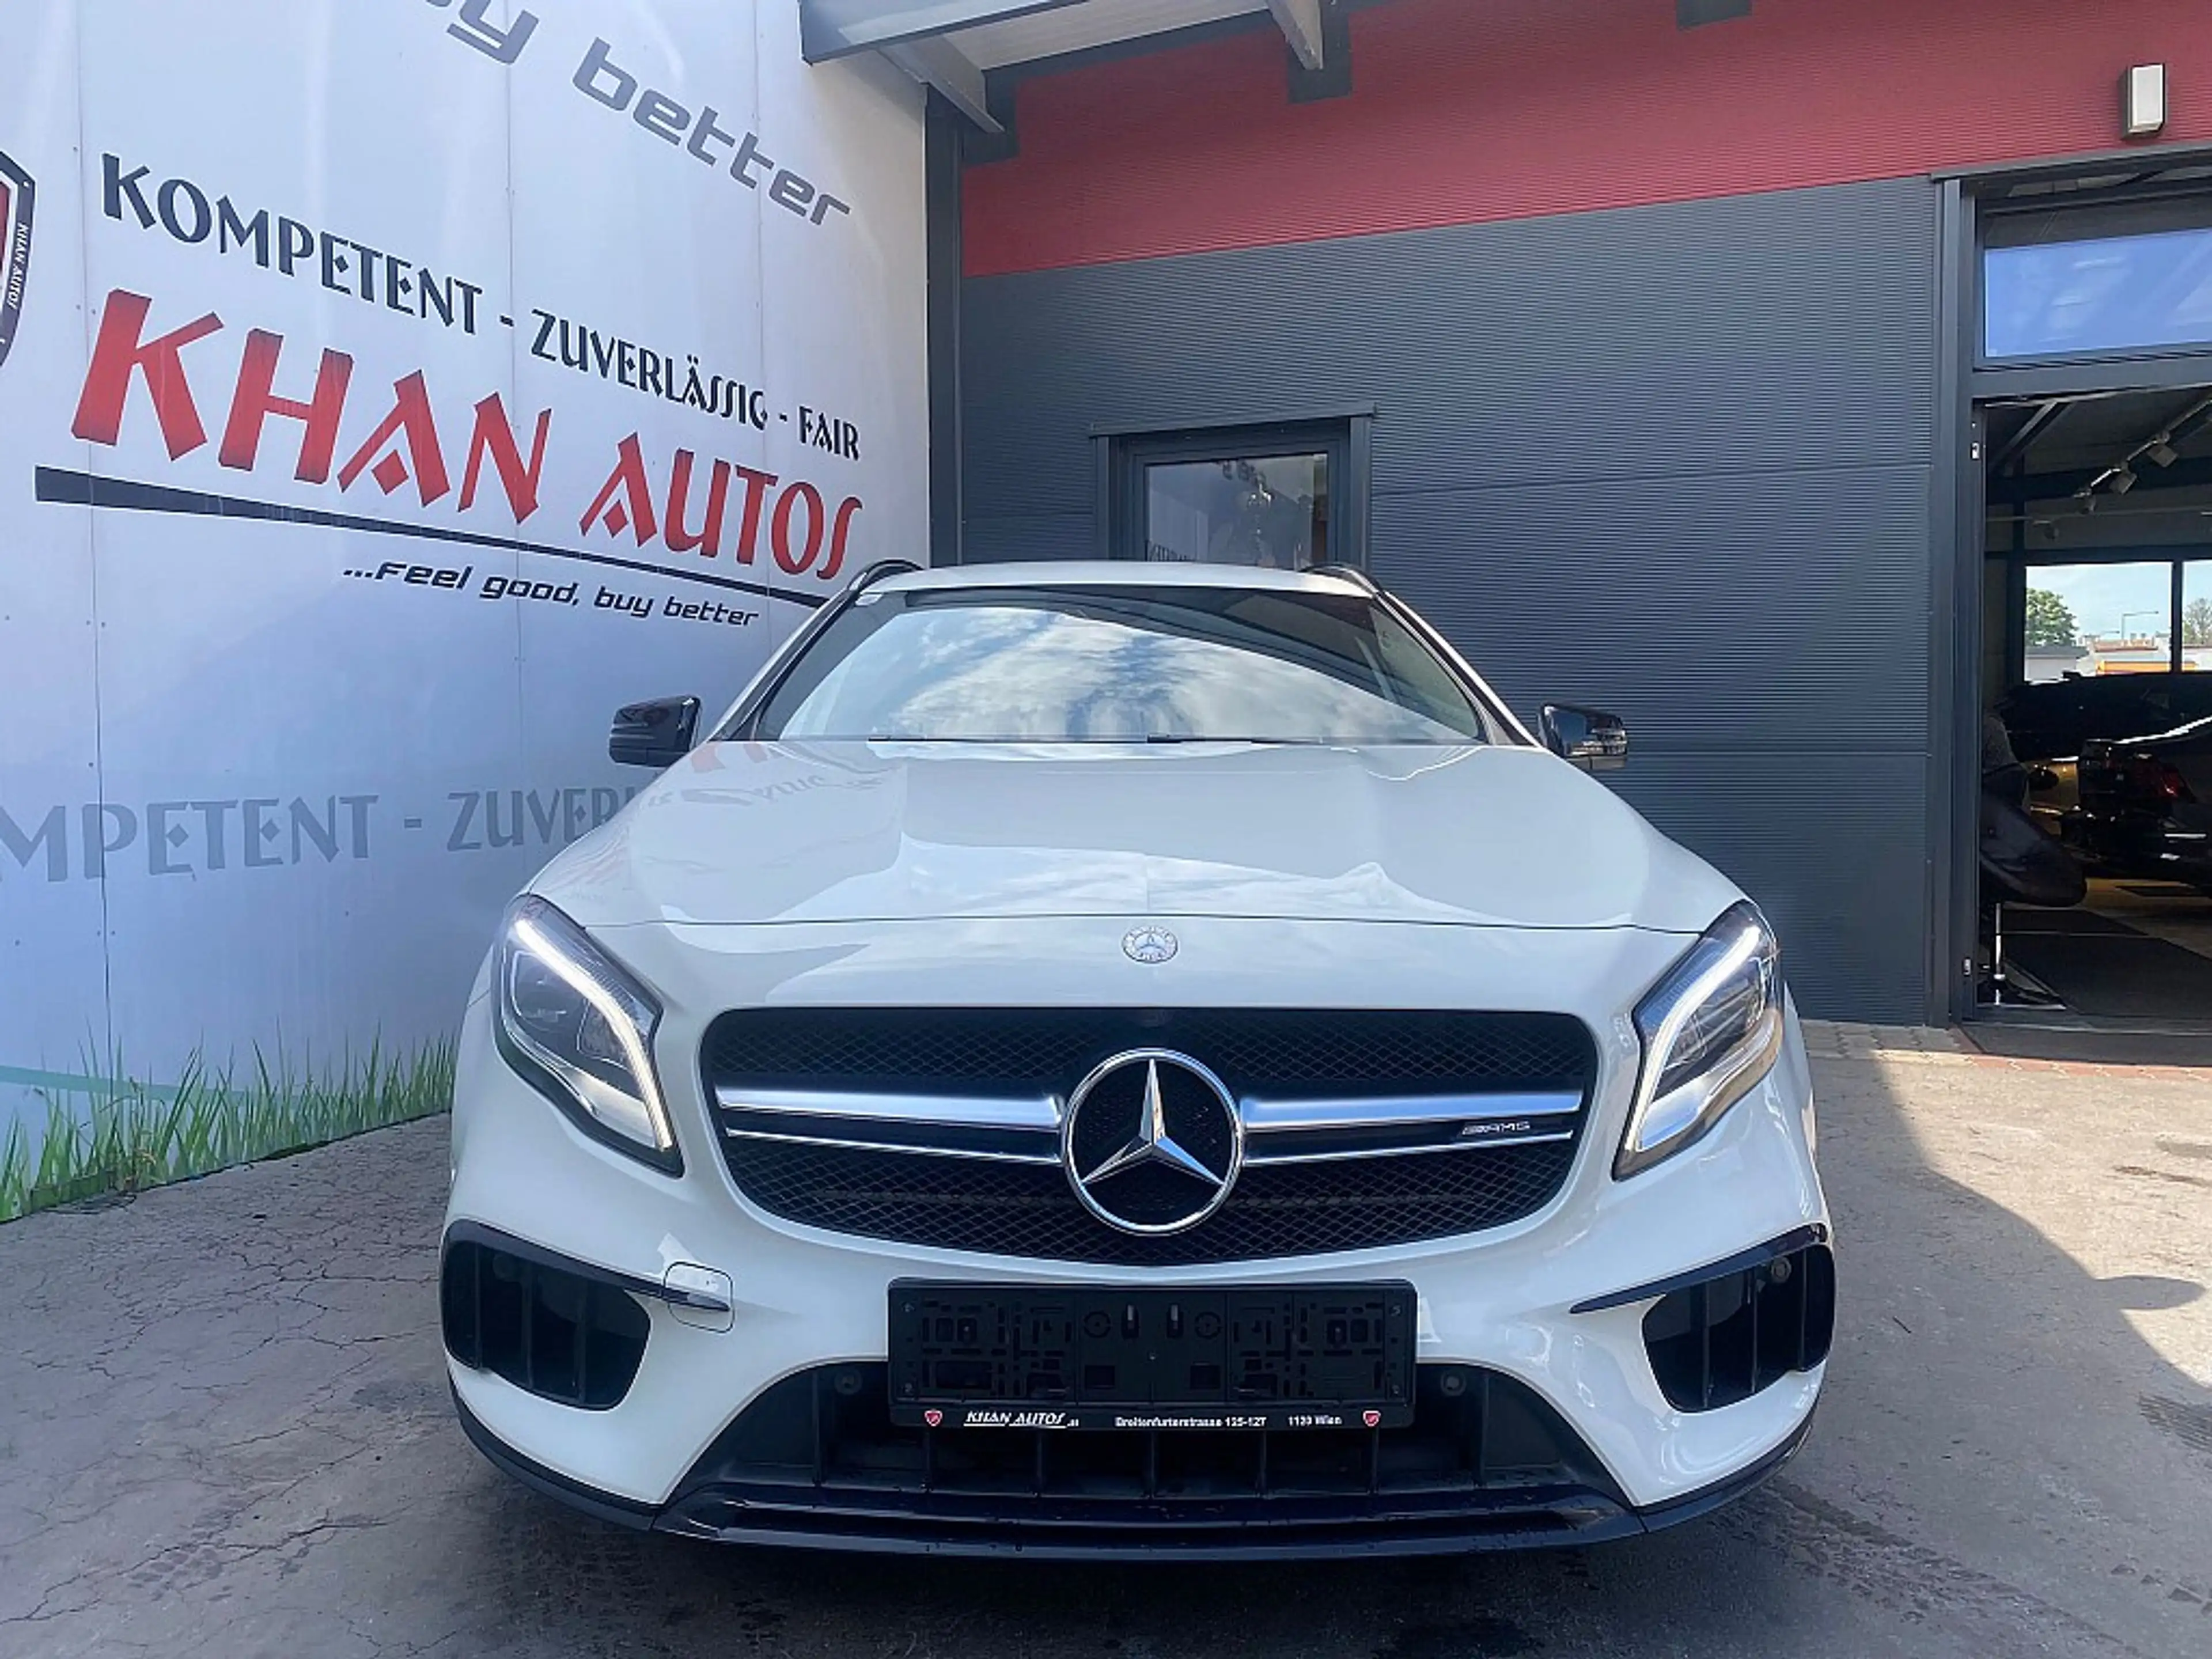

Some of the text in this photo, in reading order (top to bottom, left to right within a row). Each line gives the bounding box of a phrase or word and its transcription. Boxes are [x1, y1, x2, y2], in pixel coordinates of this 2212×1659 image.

[427, 0, 850, 225] y better
[16, 222, 29, 264] KHAN
[102, 153, 483, 334] KOMPETENT
[531, 308, 768, 431] ZUVERLÄSSIG
[798, 405, 859, 461] FAIR
[71, 288, 863, 580] KHAN AUTOS
[479, 576, 579, 605] good,
[593, 585, 654, 619] buy
[663, 596, 759, 626] better
[965, 1410, 1012, 1424] KHAN
[1013, 1412, 1066, 1426] AUTOS
